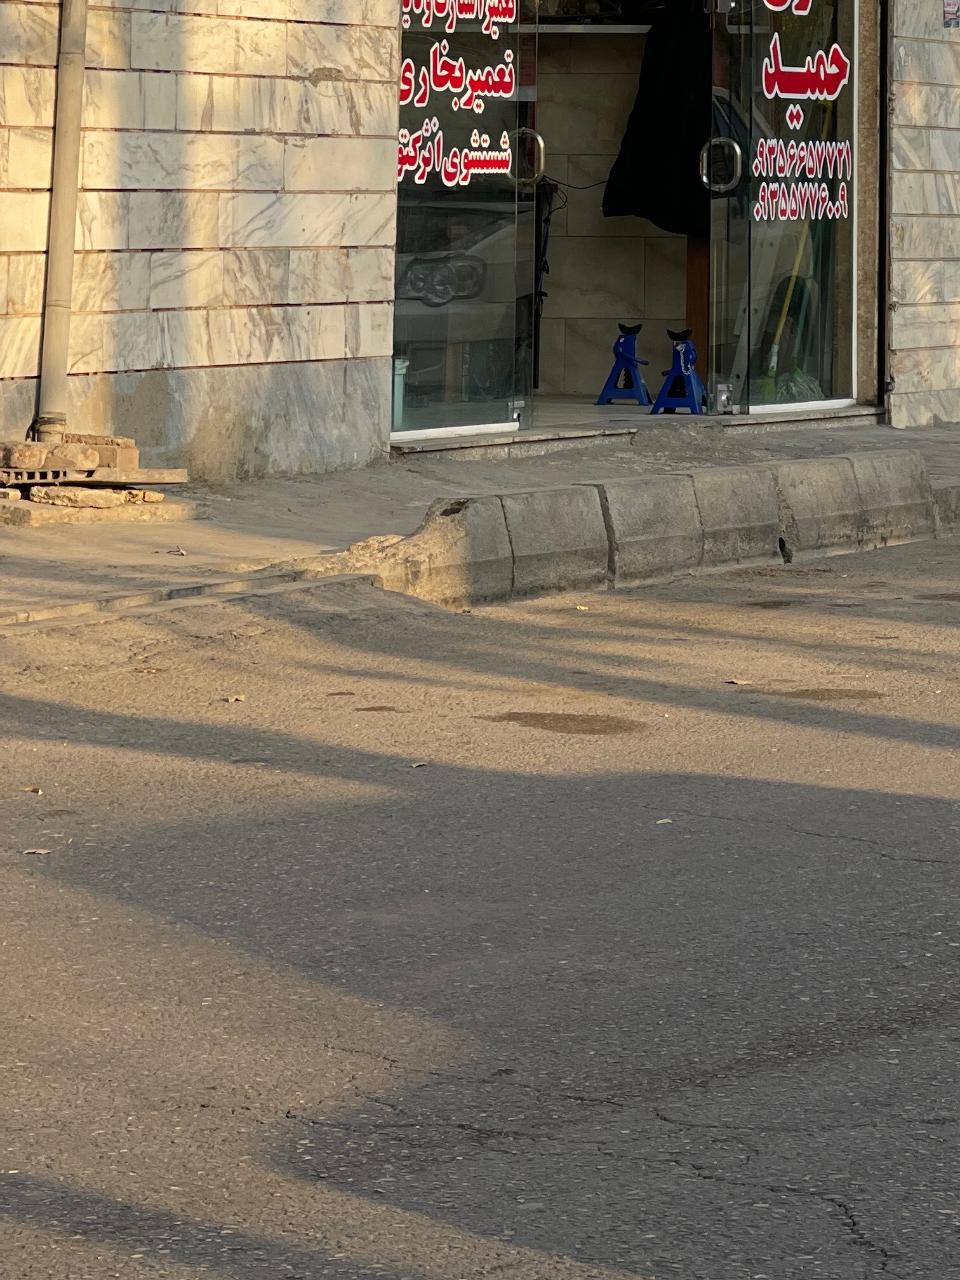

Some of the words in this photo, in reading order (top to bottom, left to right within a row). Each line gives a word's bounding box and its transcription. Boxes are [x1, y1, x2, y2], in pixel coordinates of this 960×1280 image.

[399, 39, 466, 112] بخاری
[460, 49, 515, 114] تعمیر
[762, 32, 851, 129] حمید
[397, 116, 443, 184] انژکتو
[441, 128, 512, 187] شستشوی
[754, 182, 849, 221] ۰۹۳۵۵۷۷۶۰۰۹
